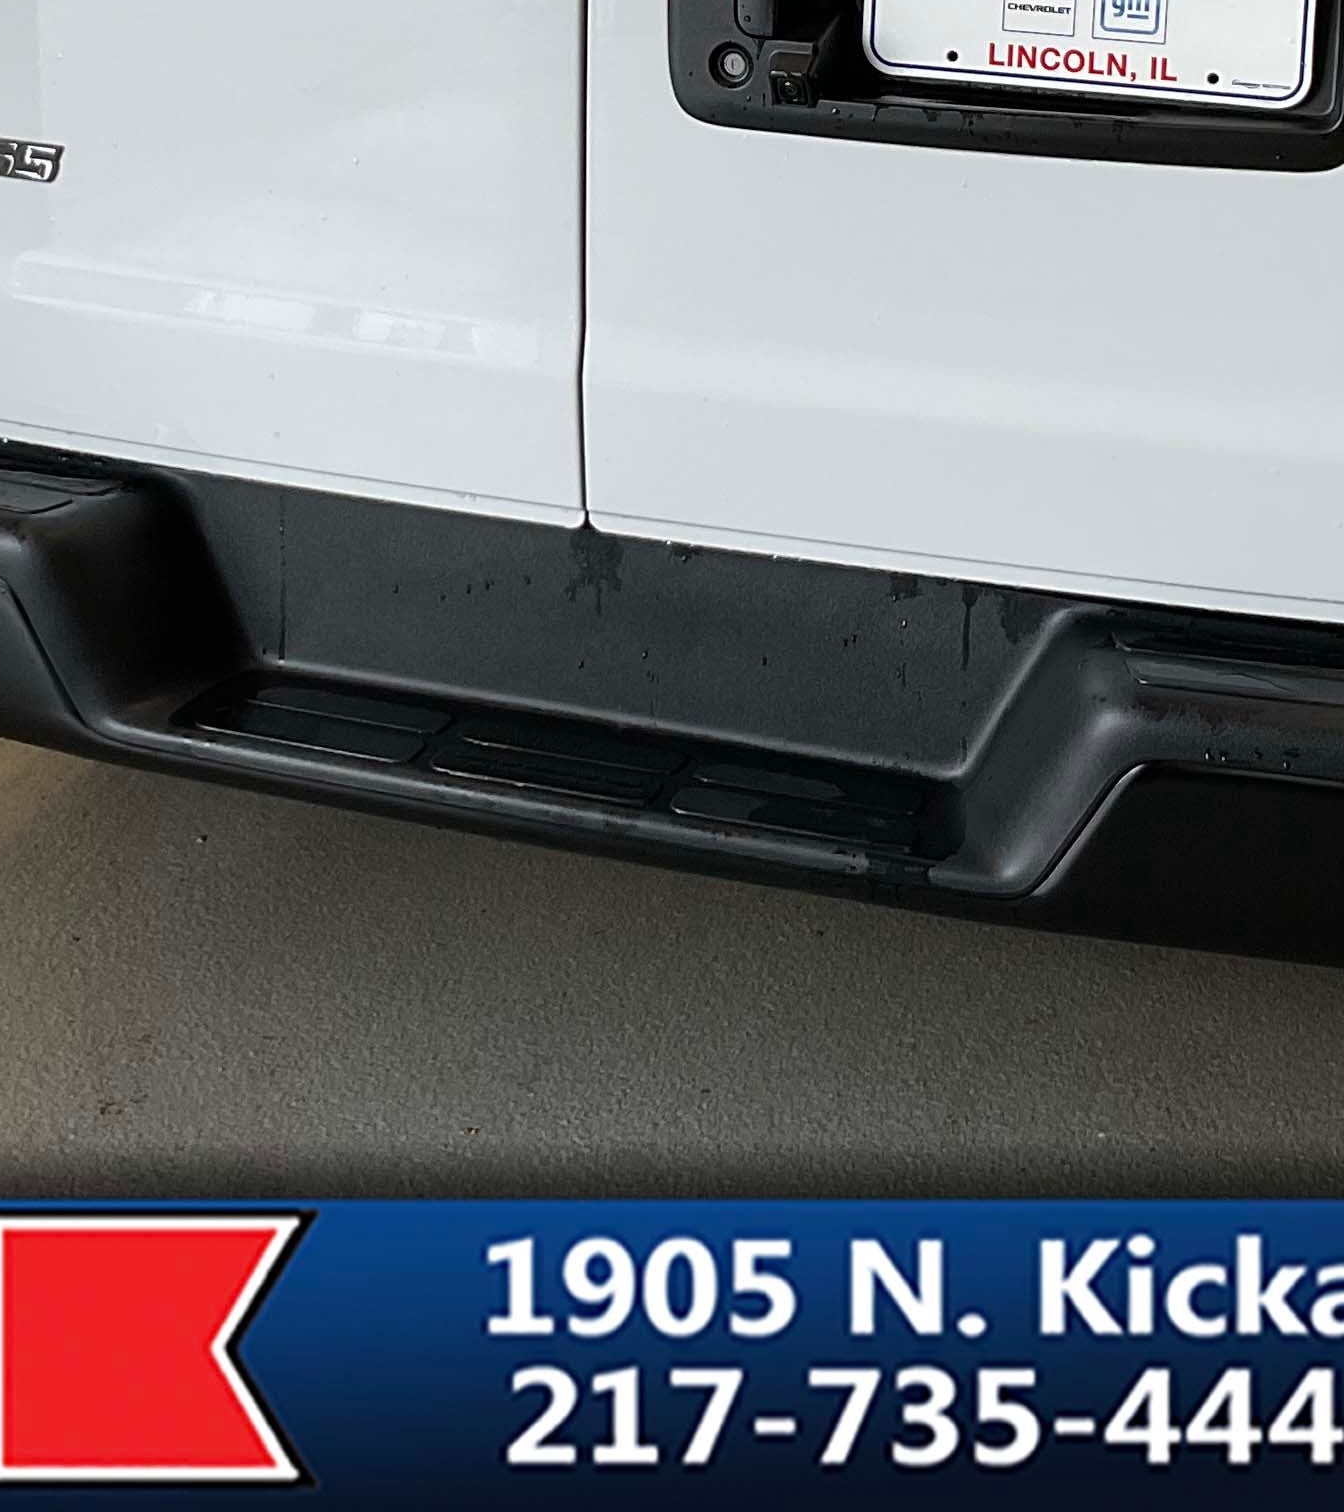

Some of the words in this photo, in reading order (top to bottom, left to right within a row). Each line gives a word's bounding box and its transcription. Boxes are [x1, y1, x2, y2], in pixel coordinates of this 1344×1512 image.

[1007, 2, 1072, 15] CHEVROLET
[988, 42, 1137, 82] LINCOLN,
[1150, 56, 1178, 82] IL
